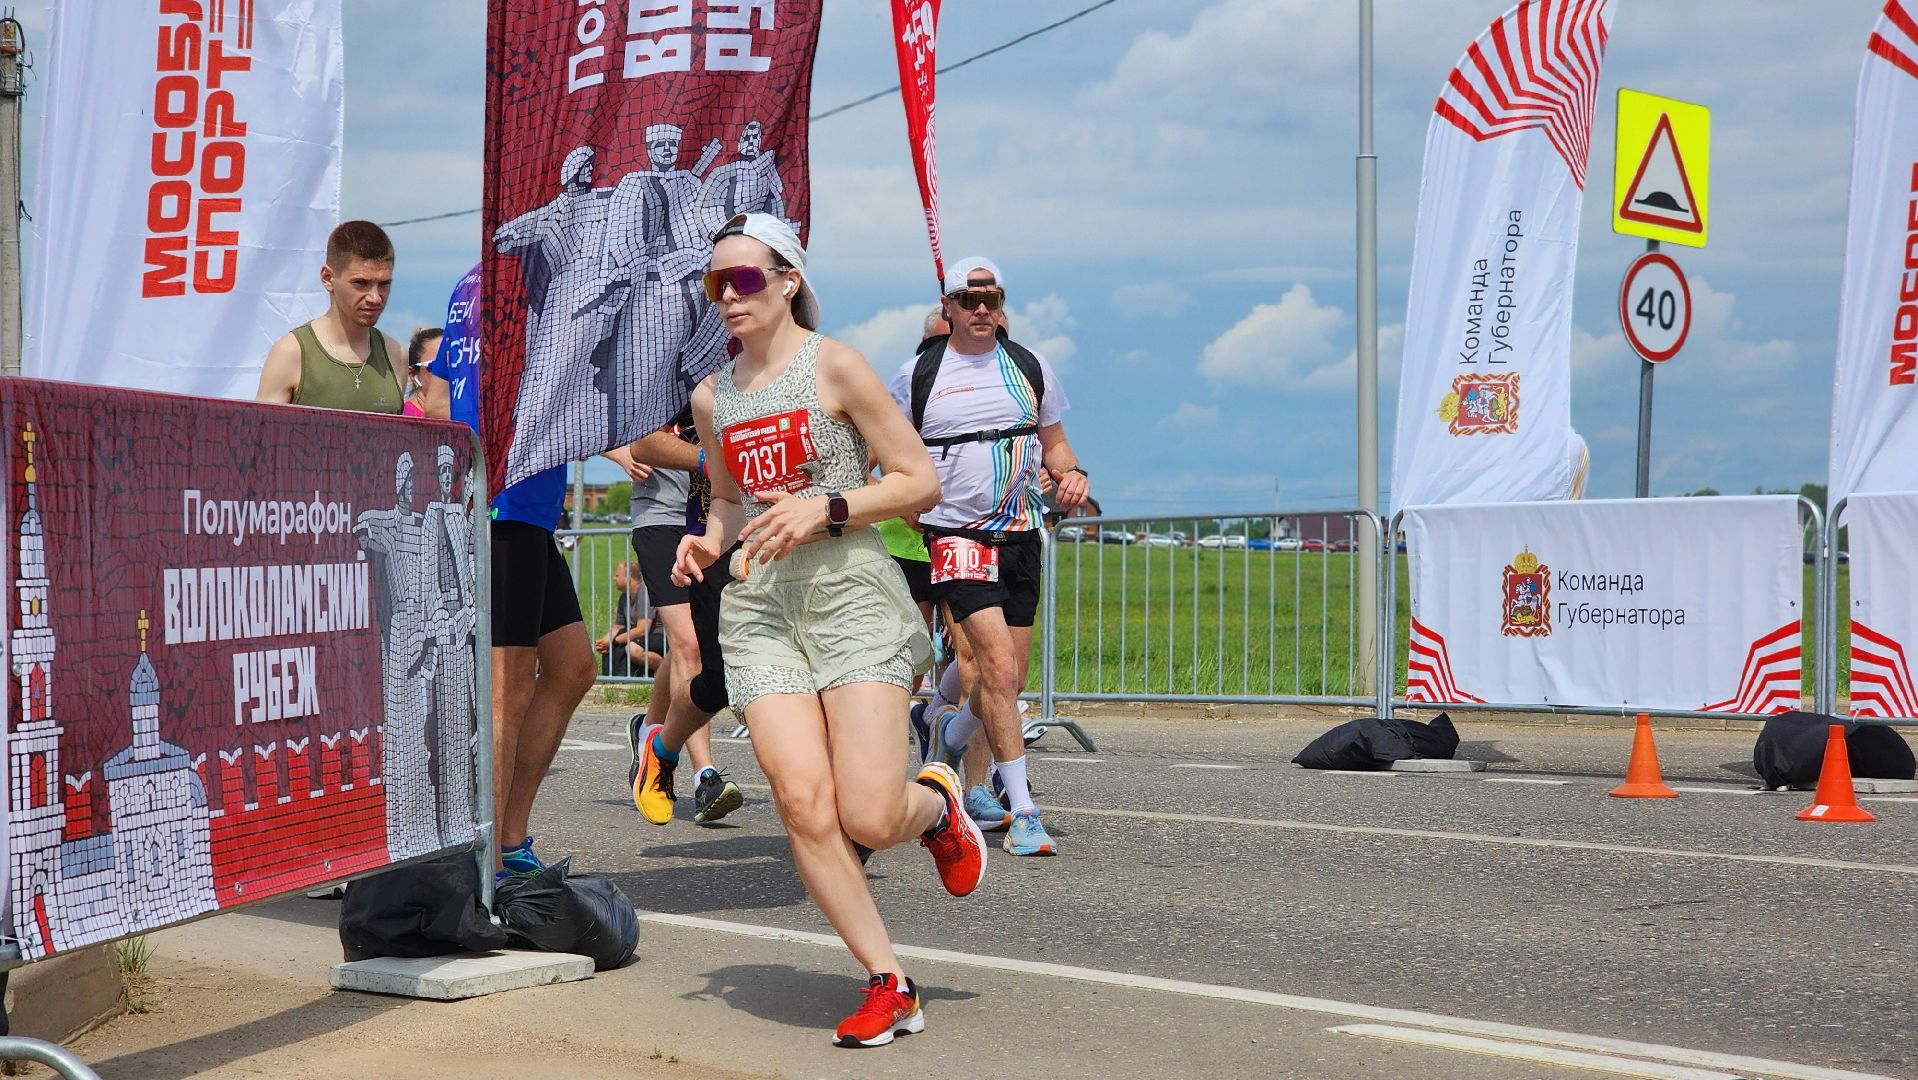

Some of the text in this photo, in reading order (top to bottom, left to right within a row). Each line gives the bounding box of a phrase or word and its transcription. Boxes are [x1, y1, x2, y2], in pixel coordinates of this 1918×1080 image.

[569, 0, 605, 94] По
[193, 39, 251, 294] СПОРТ
[1459, 258, 1490, 364] Команда
[1488, 210, 1524, 364] Губернатора
[1636, 286, 1676, 331] 40
[738, 441, 787, 485] 2137
[183, 489, 351, 546] Полумарафон
[163, 550, 369, 645] ВОЛОКОЛАМСКИЙ
[1558, 569, 1645, 596] Команда
[1558, 602, 1686, 631] Губернатора
[233, 646, 320, 726] РУБЕЖ
